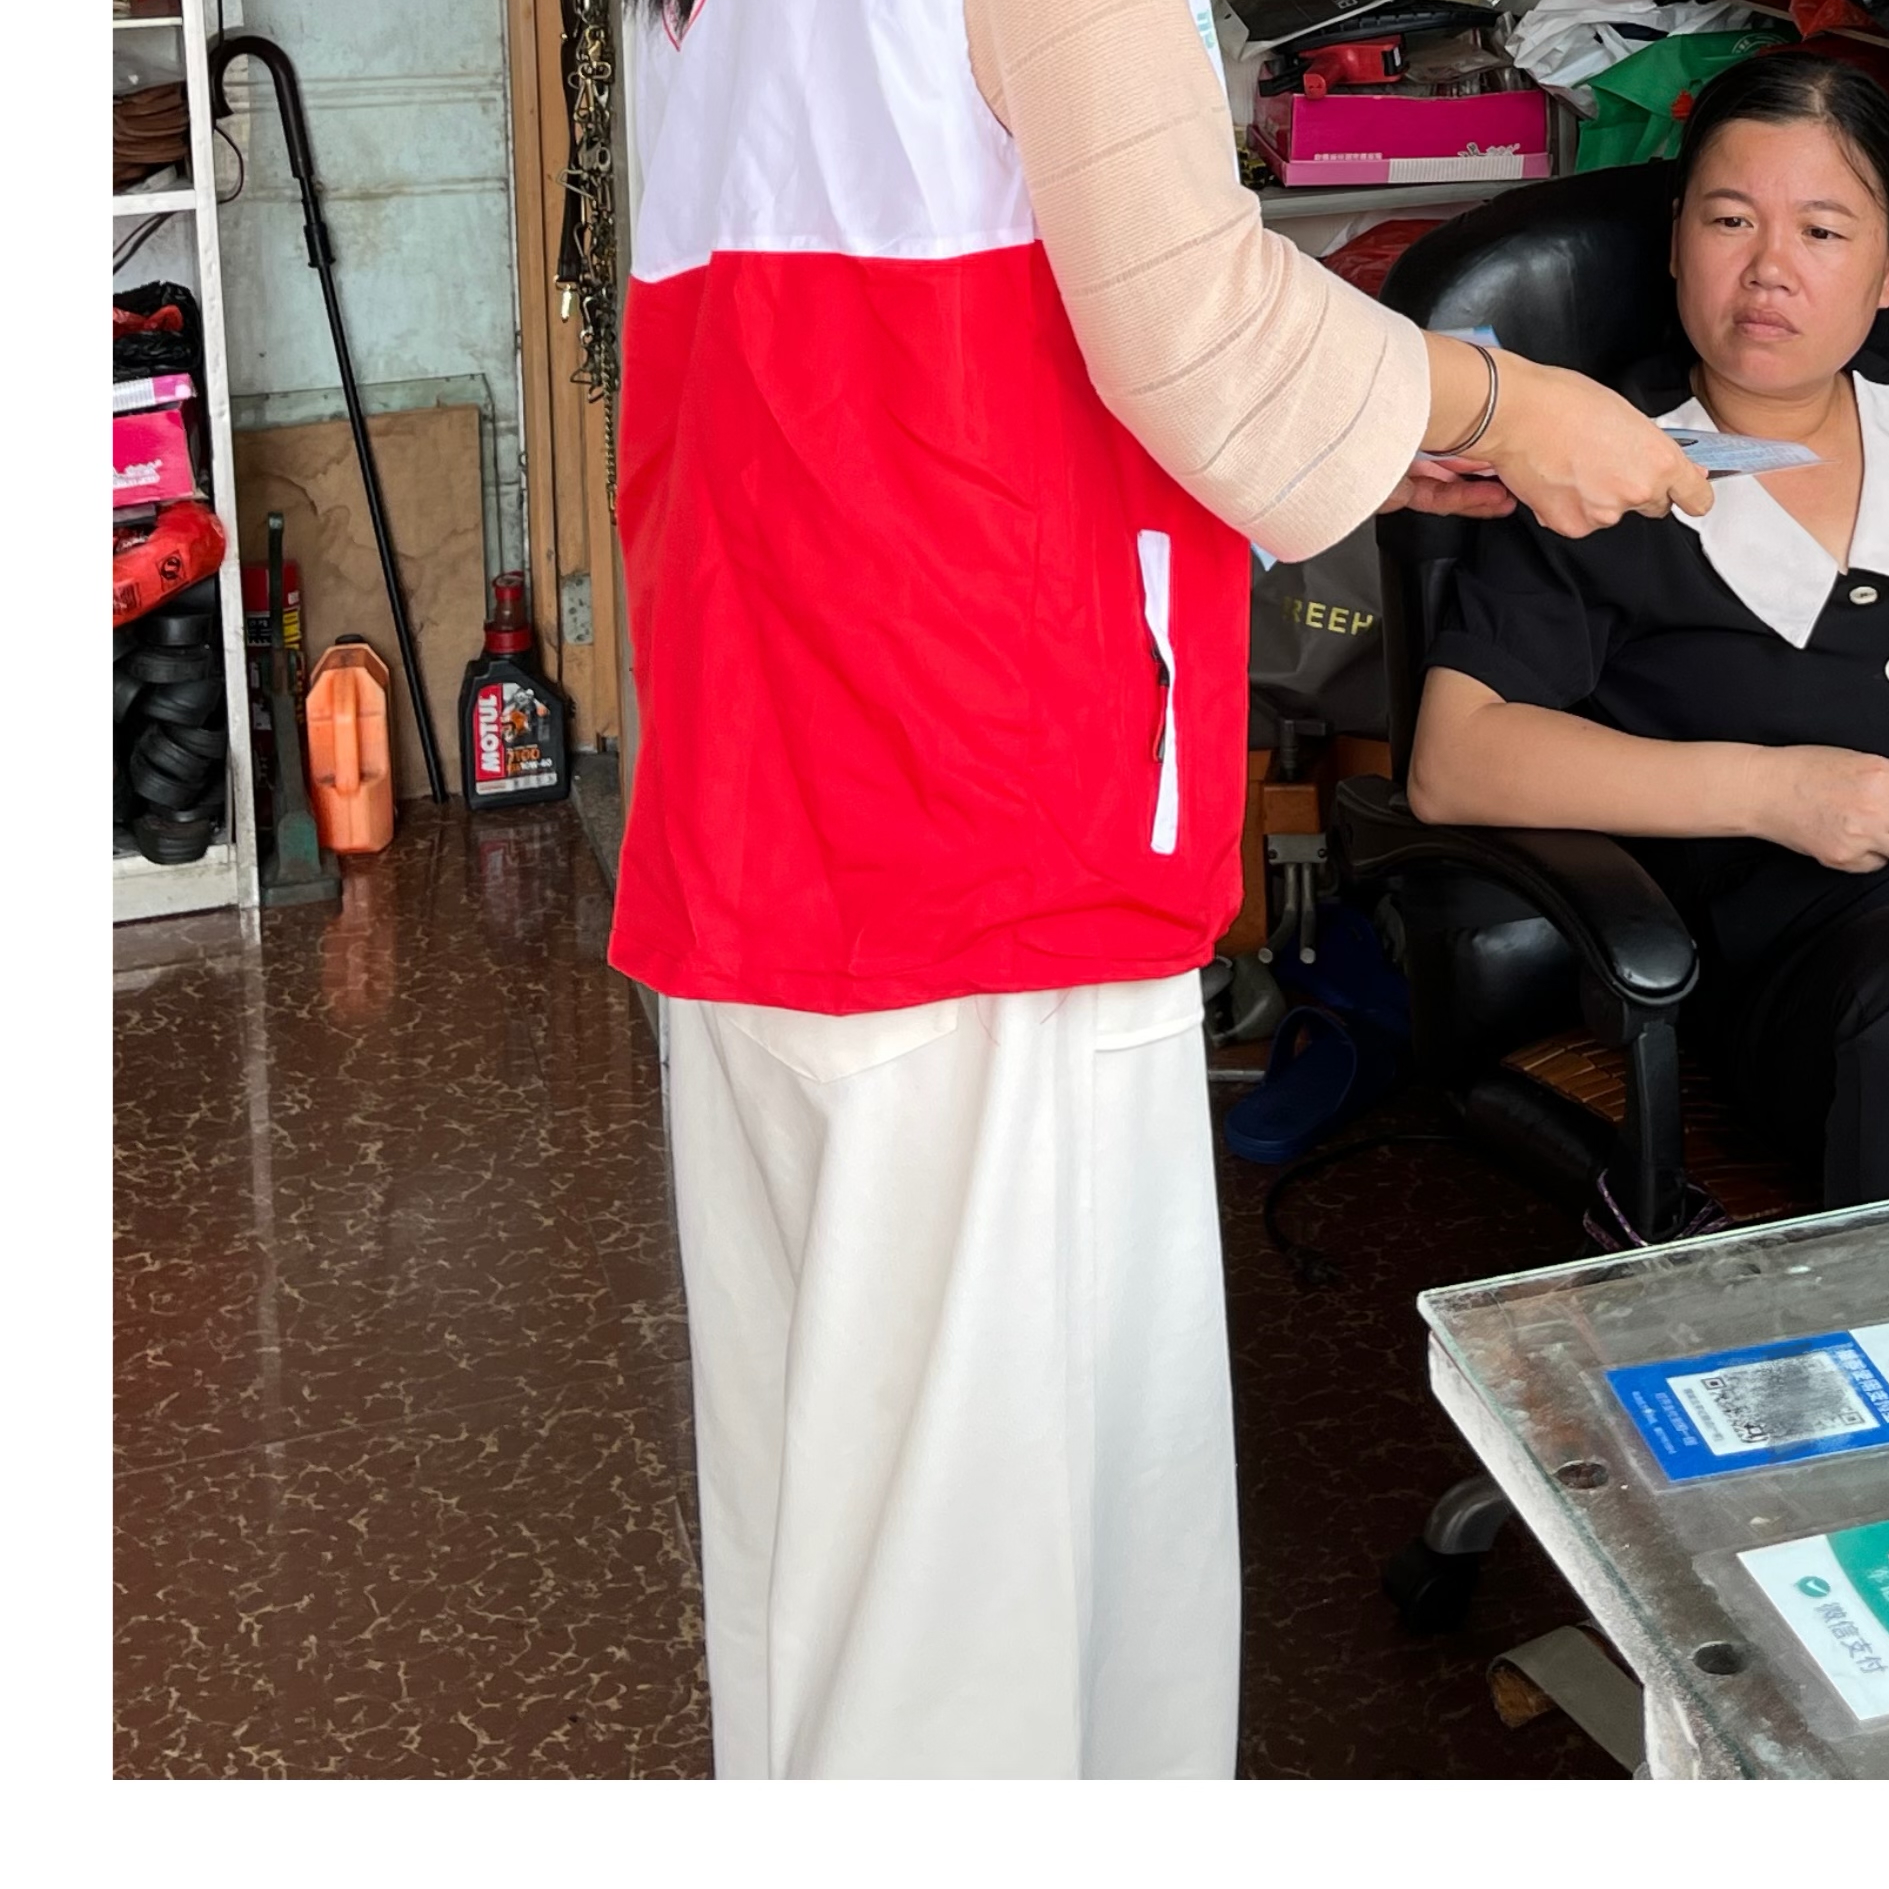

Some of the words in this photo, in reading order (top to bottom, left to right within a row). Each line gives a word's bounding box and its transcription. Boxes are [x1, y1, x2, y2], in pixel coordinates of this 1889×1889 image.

[479, 694, 501, 773] MOTUL
[1814, 1602, 1888, 1676] 微信支付
